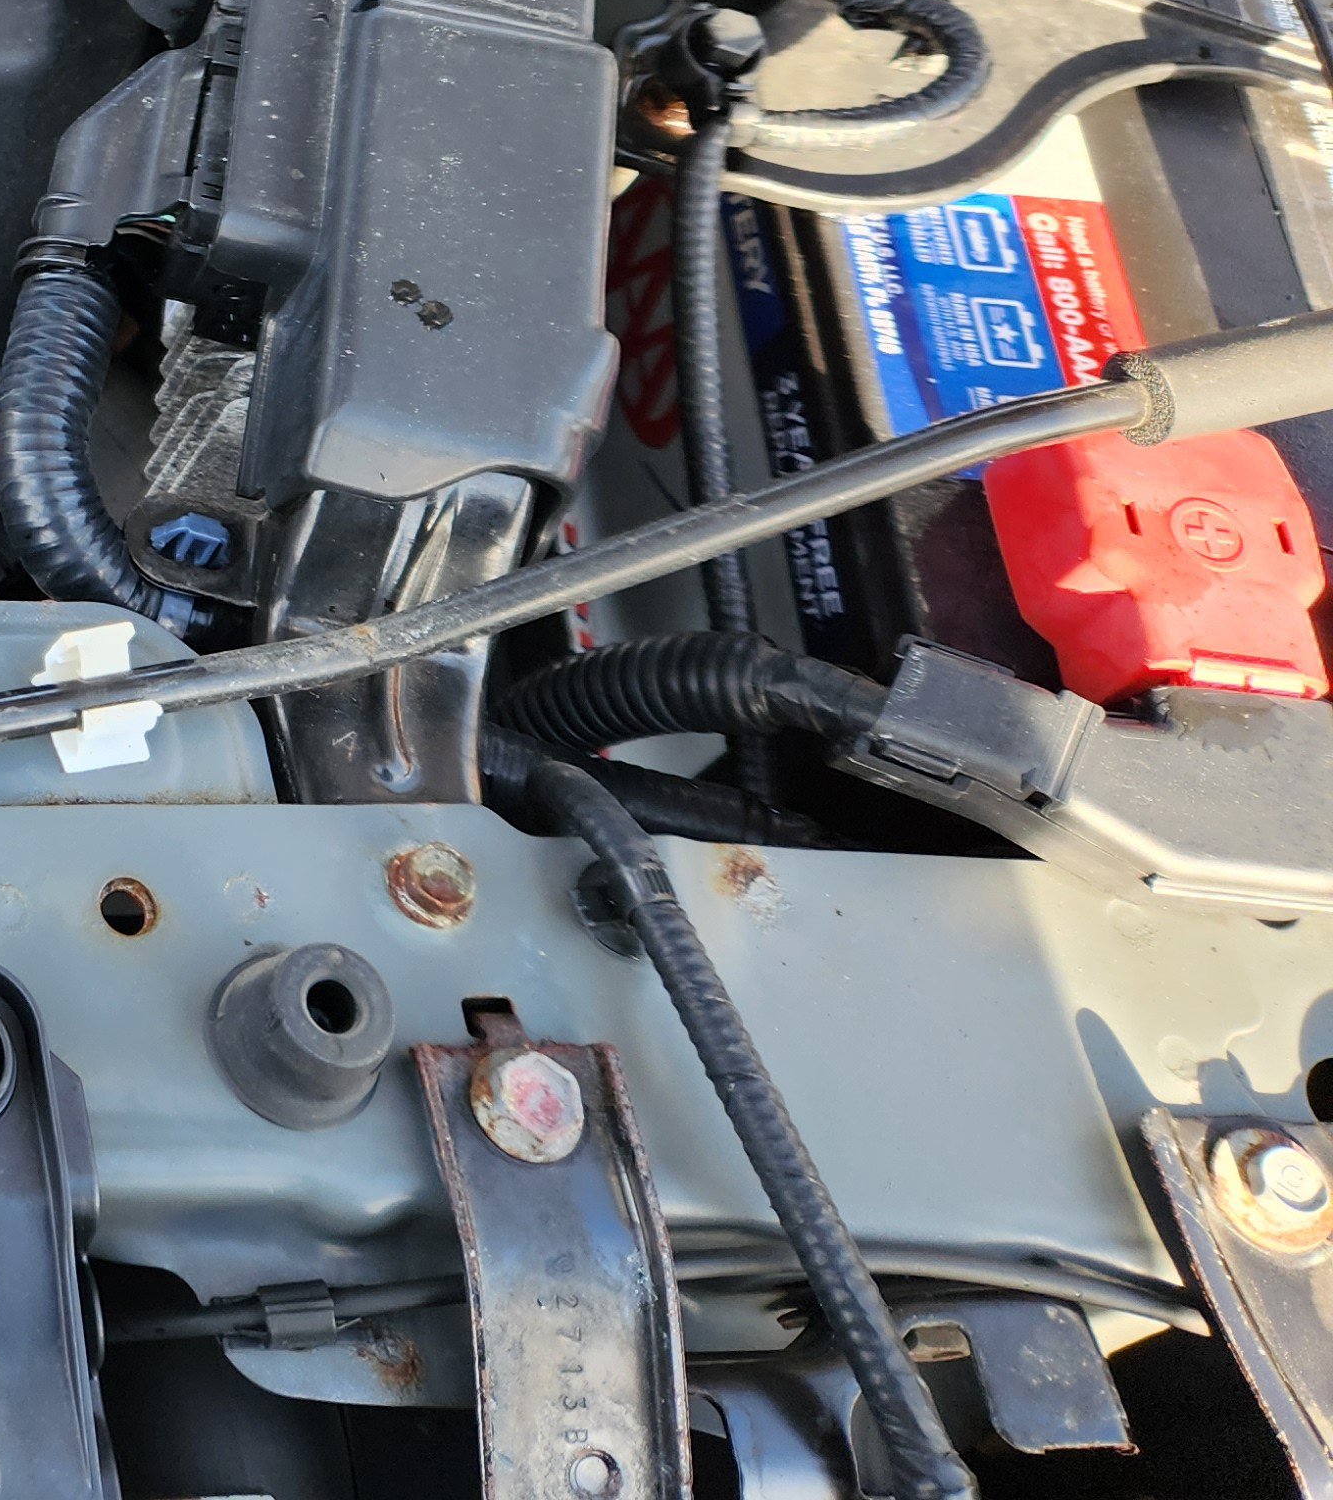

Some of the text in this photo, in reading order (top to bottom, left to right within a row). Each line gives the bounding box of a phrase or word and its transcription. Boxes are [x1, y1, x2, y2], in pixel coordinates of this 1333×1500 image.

[1027, 212, 1068, 270] Call:
[1063, 215, 1094, 255] Need
[1080, 269, 1108, 319] battery
[1097, 323, 1115, 339] or
[785, 401, 815, 472] YEA
